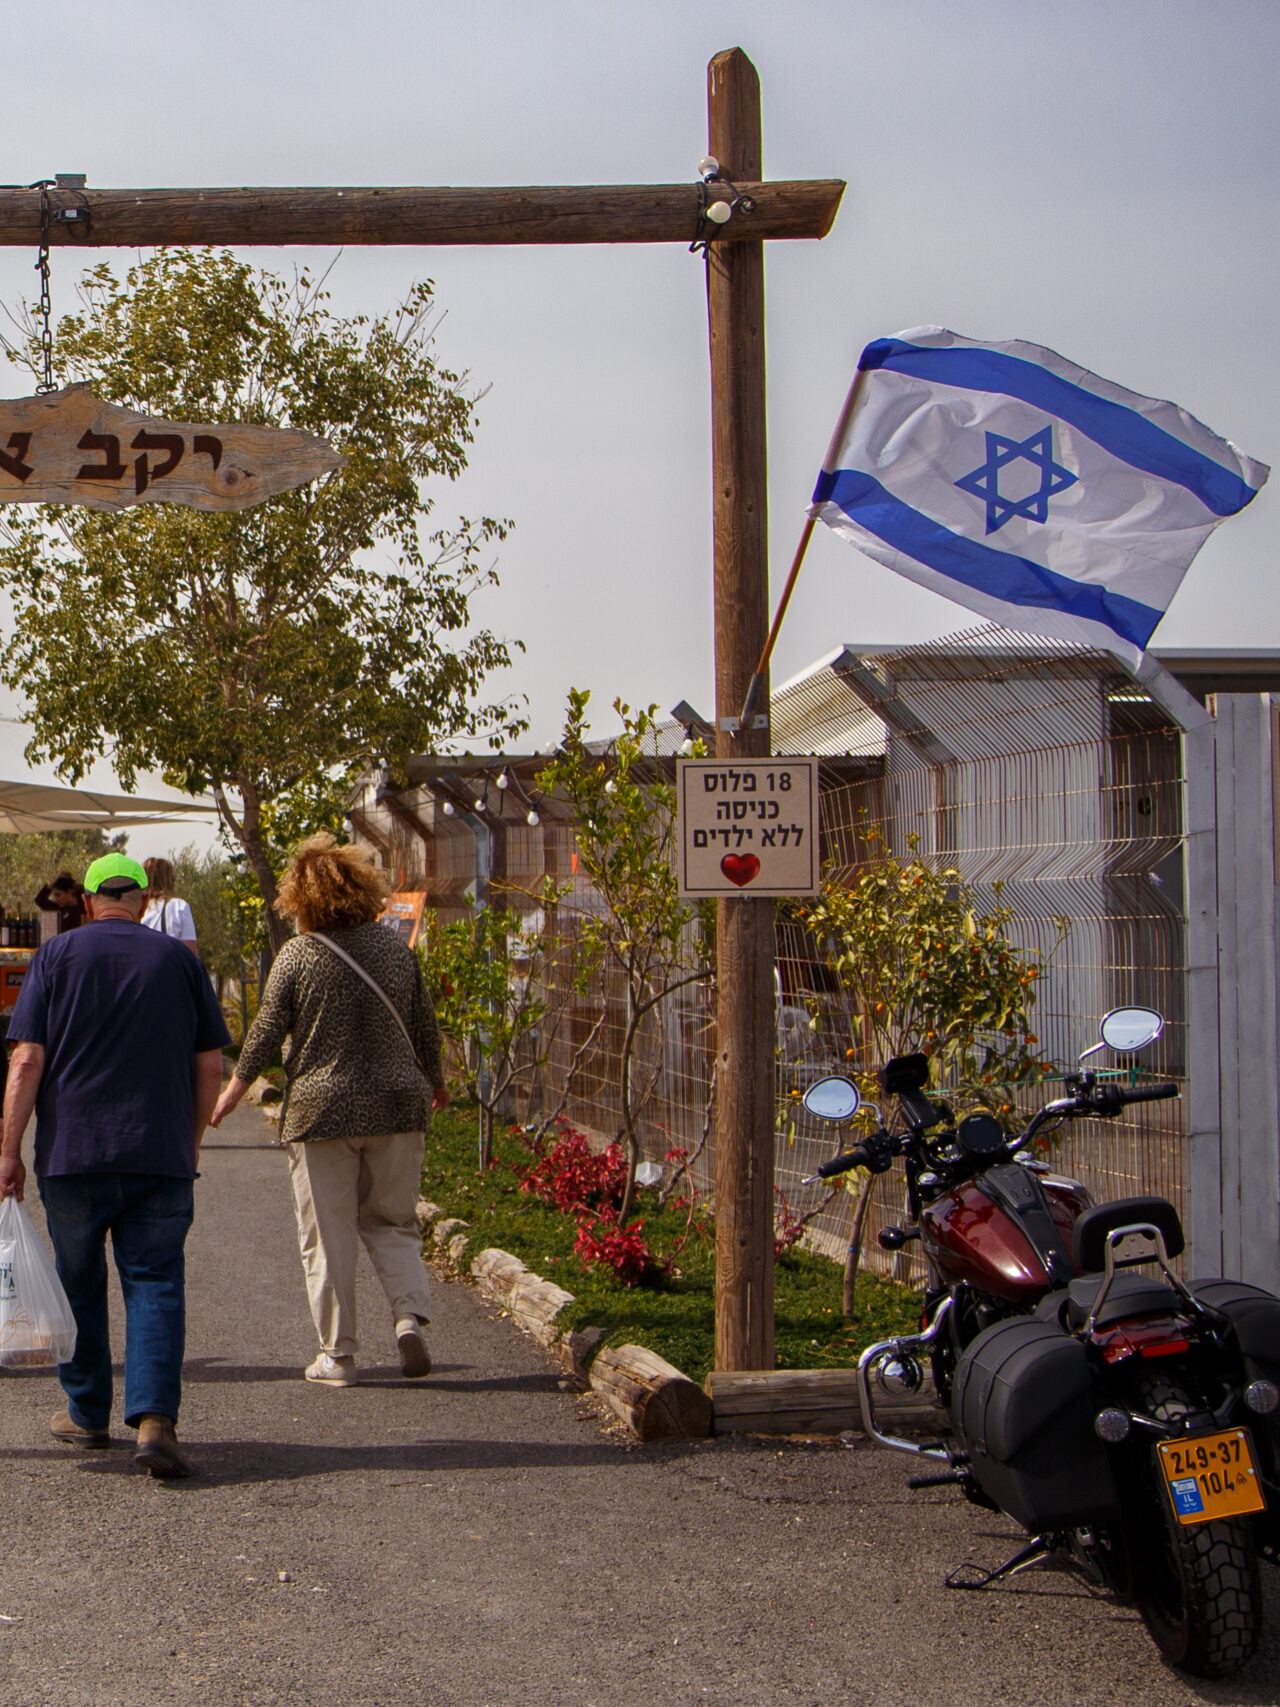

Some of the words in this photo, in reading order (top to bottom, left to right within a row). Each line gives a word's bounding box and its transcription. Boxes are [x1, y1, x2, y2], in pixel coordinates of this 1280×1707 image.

[76, 428, 223, 496] יקב
[703, 768, 757, 793] פלוס
[766, 772, 792, 792] 18
[716, 800, 780, 820] כניסה
[693, 824, 754, 849] ילדים
[761, 823, 805, 848] ללא
[1198, 1469, 1235, 1497] 104
[1183, 1493, 1194, 1504] IL
